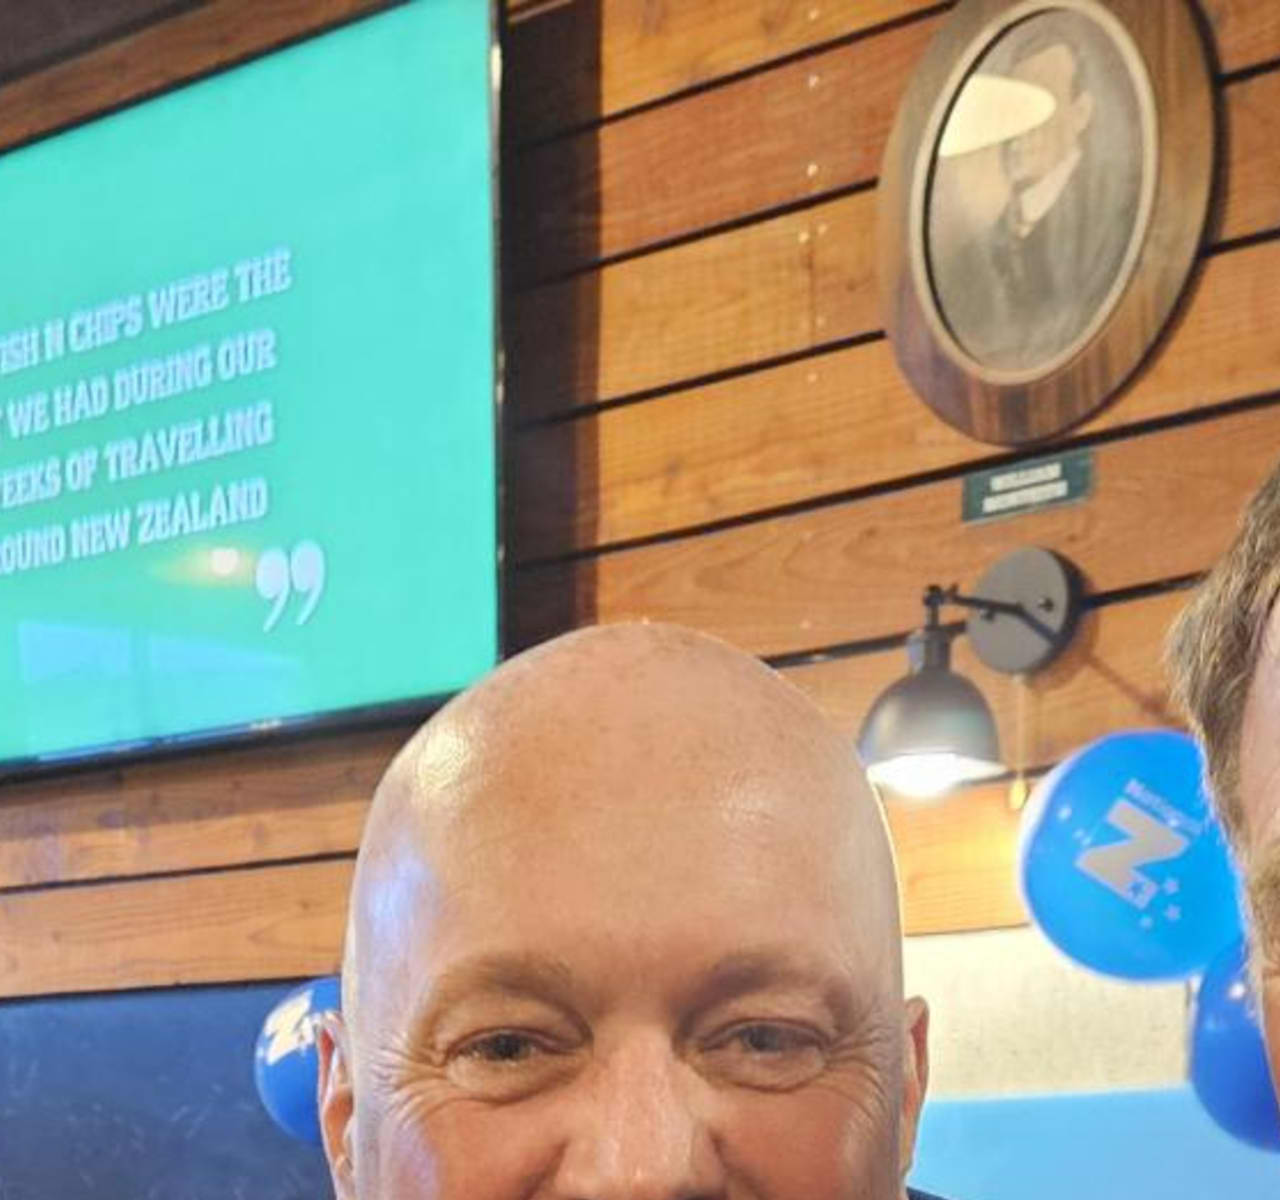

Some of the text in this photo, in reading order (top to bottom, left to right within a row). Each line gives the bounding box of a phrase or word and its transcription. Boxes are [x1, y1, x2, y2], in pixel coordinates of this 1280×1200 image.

[44, 317, 65, 361] N
[68, 293, 143, 353] CHIPS
[147, 268, 229, 328] WERE
[234, 246, 292, 302] THE
[7, 389, 49, 438] WE
[53, 374, 108, 428] HAD
[114, 344, 213, 411] DURING
[217, 328, 277, 381] OUR
[66, 445, 98, 492] OF
[104, 401, 276, 482] TRAVELLING
[70, 504, 133, 560] NEW
[137, 476, 269, 544] ZEALAND
